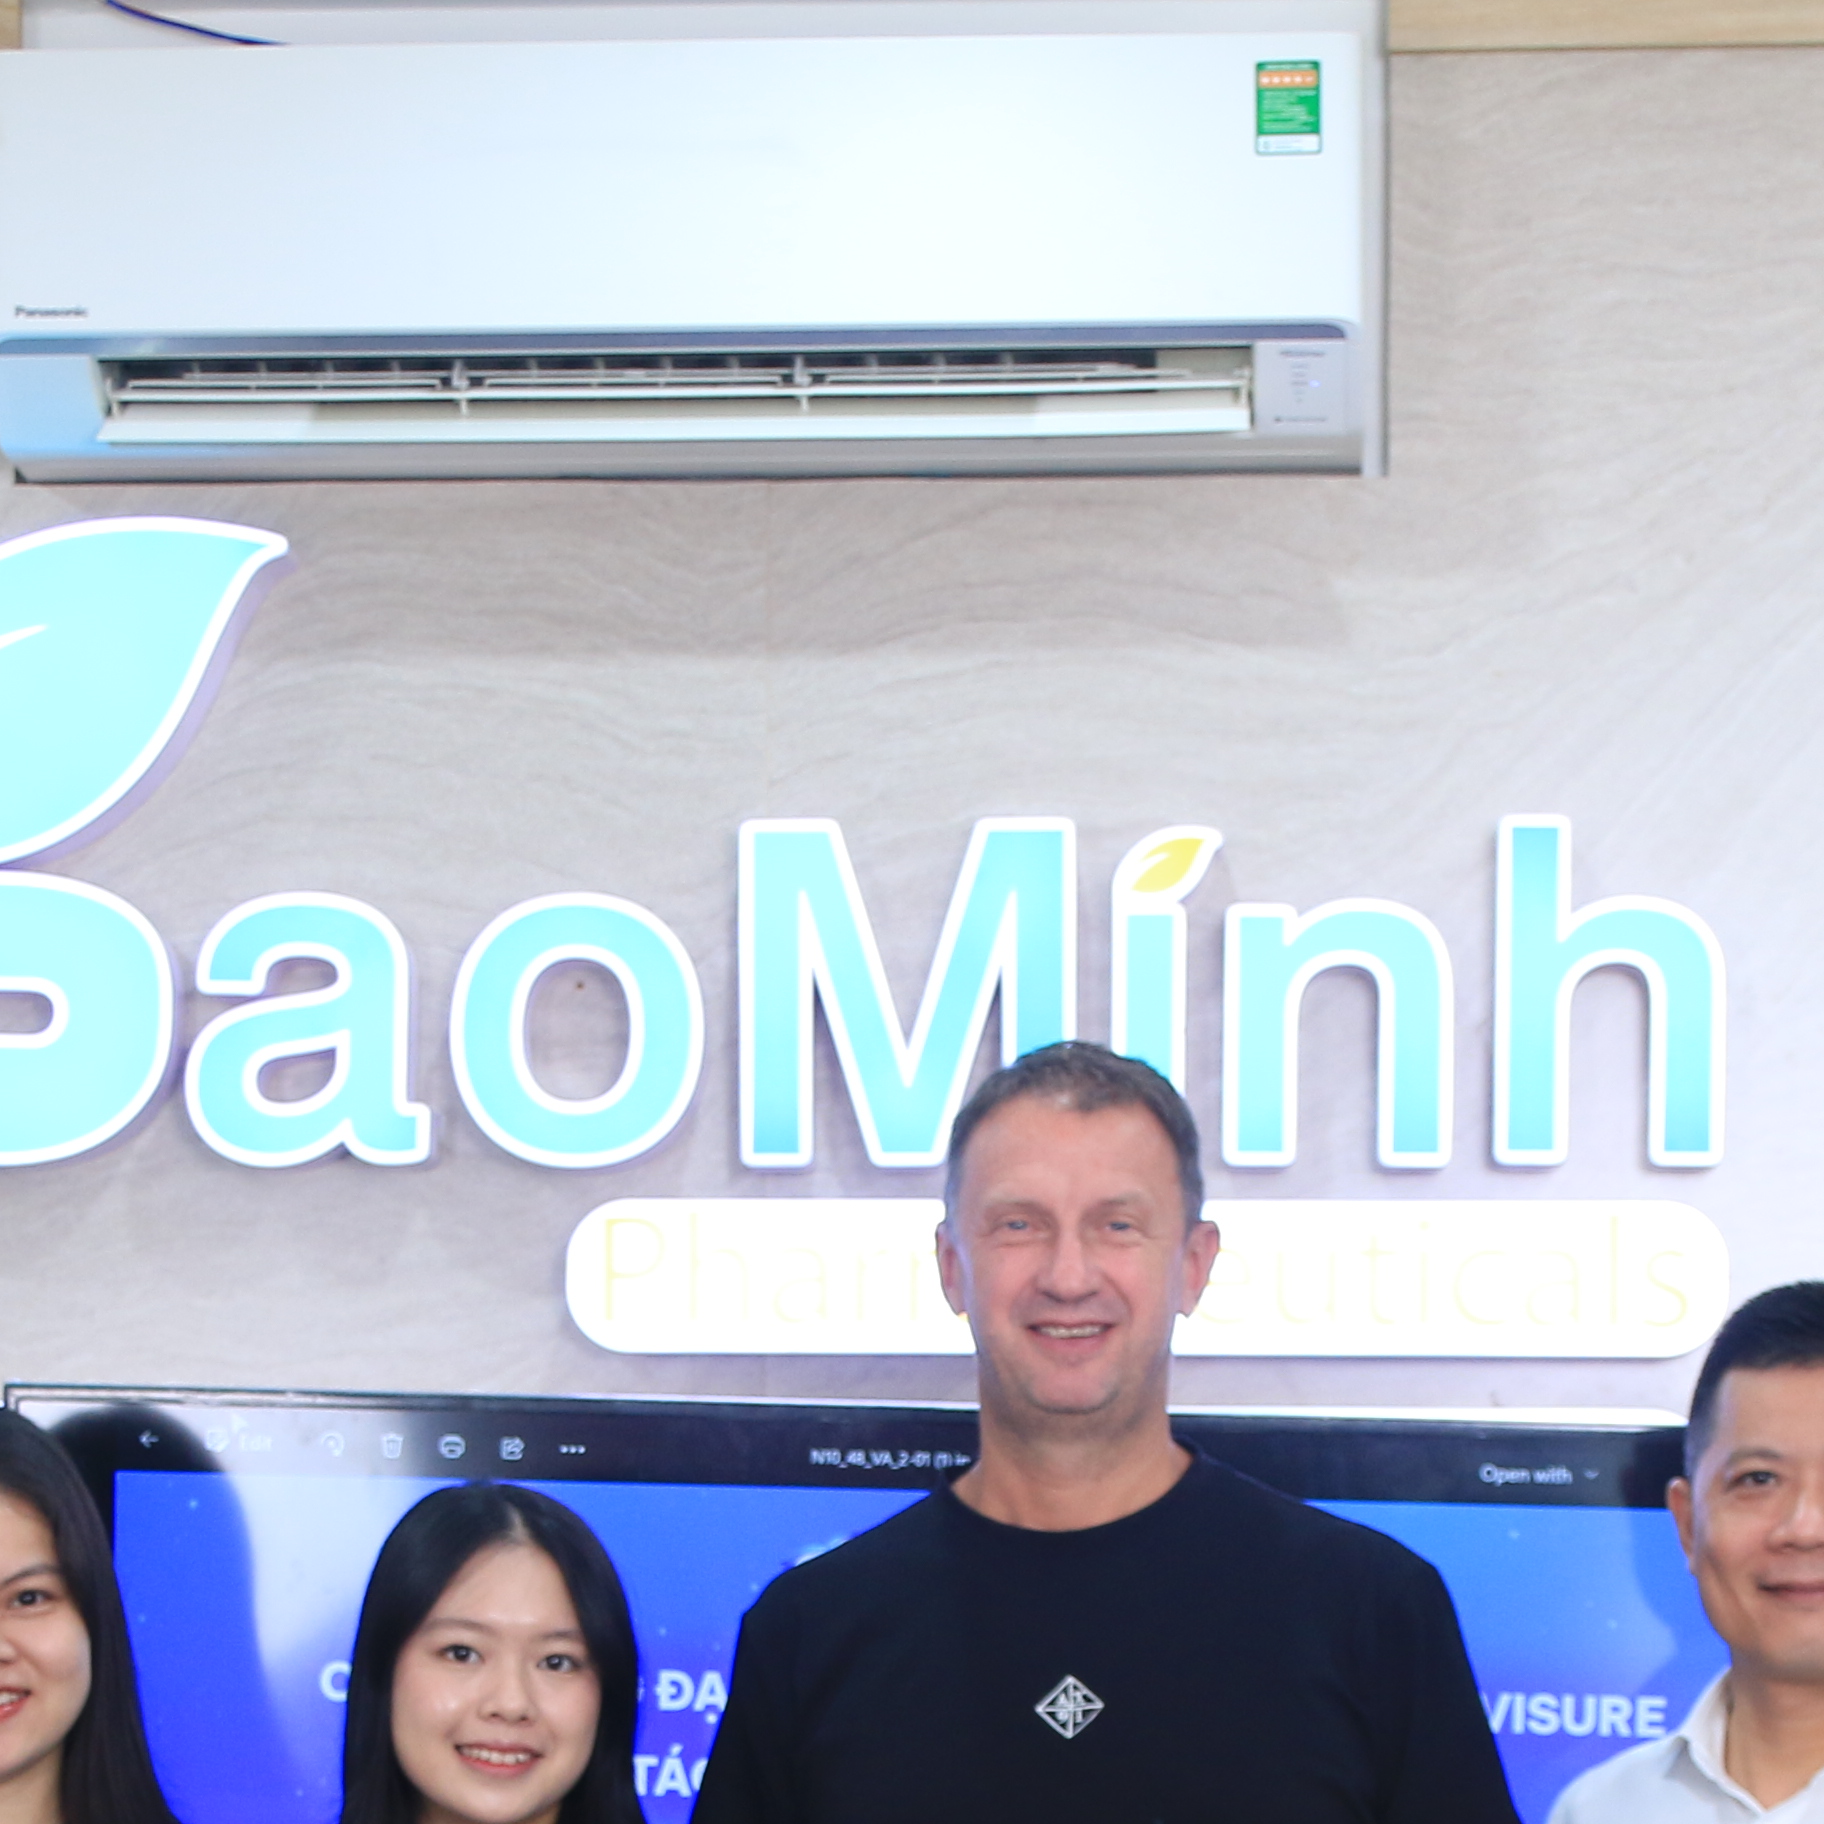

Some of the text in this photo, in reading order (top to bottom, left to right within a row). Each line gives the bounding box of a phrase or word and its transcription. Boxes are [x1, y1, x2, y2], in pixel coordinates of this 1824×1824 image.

[14, 304, 89, 318] Panasonic
[1479, 1463, 1573, 1486] Open with
